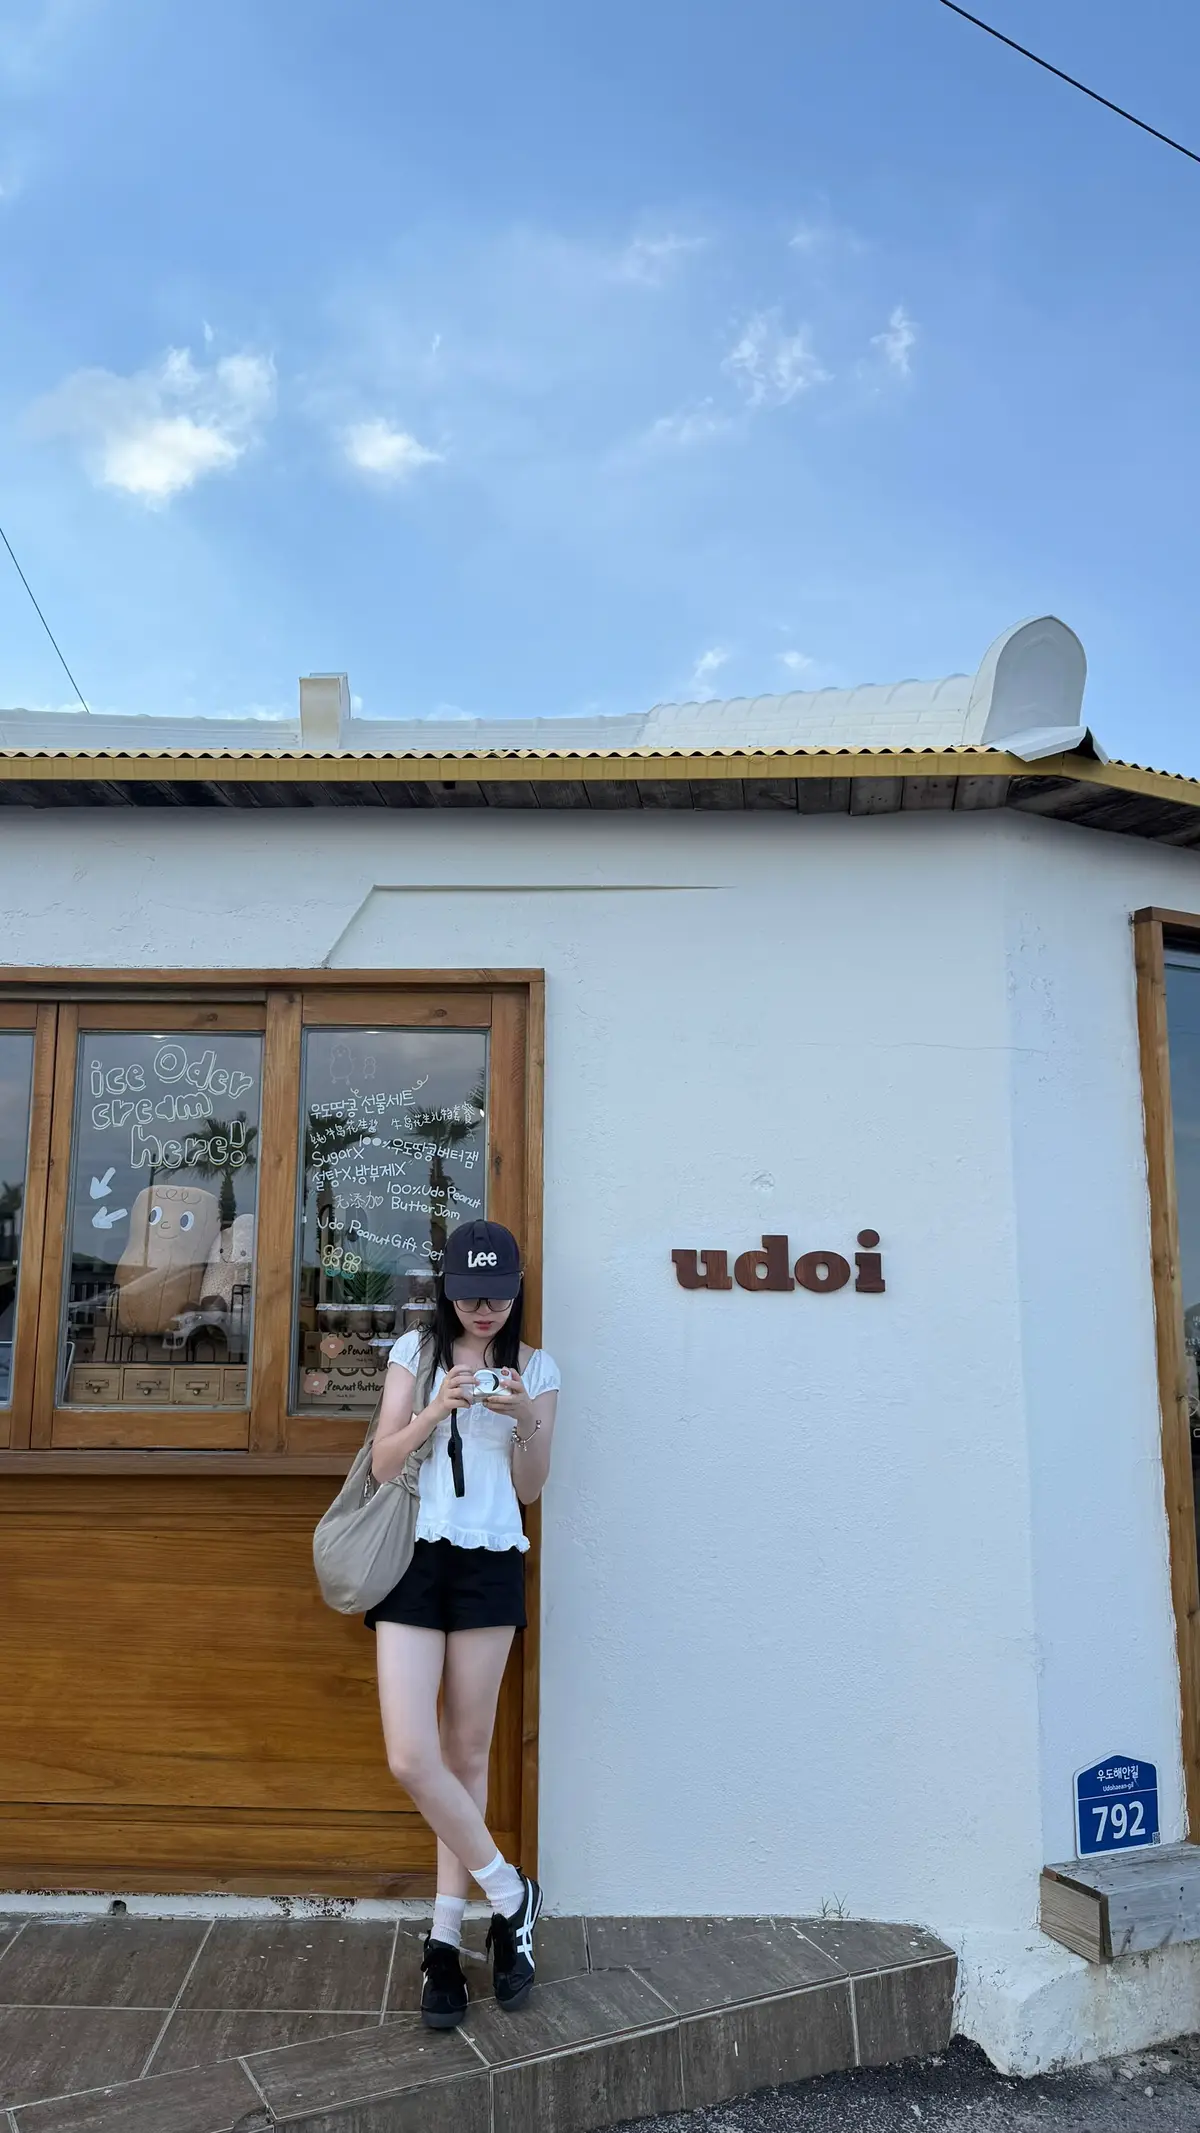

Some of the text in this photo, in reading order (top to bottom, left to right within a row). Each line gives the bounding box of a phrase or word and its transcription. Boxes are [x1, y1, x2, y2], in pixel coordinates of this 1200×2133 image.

[90, 1044, 254, 1099] ice Oder
[92, 1092, 213, 1130] cream
[310, 1089, 416, 1119] 우도땅콩 선물세트
[130, 1120, 247, 1169] here!
[447, 1186, 482, 1209] Peanut
[316, 1217, 445, 1261] Udo Peanut Gift Set
[467, 1250, 498, 1268] Lee
[671, 1228, 886, 1293] udoi
[1096, 1765, 1139, 1781] 우도해안길
[1102, 1782, 1134, 1792] Udohaean-gil
[1092, 1800, 1146, 1842] 792
